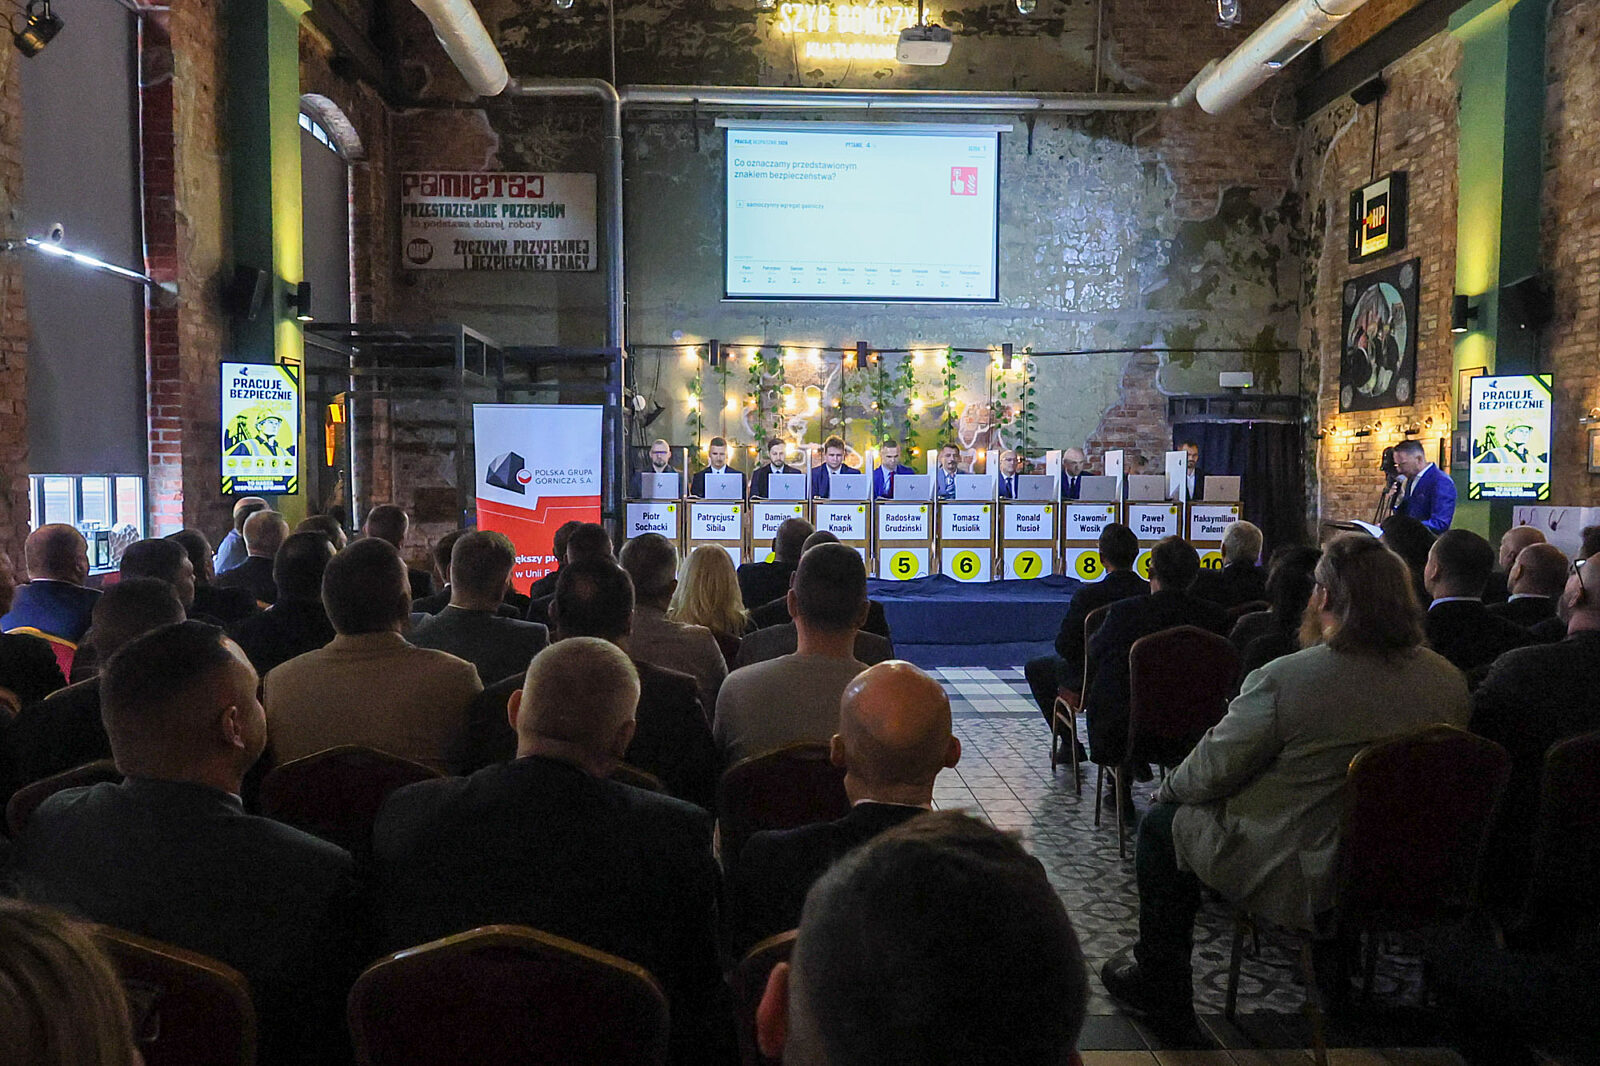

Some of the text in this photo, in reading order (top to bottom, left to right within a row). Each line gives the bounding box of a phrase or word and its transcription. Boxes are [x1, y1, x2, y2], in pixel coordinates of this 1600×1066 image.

[837, 0, 930, 36] BOŃCZY
[734, 158, 856, 171] Co oznaczamy przedstawionym
[734, 170, 836, 180] znakiem bezpieczeństwa?
[402, 201, 565, 218] PRZESTRZEGANIE PRZEPISÓW
[423, 220, 471, 230] podstawa
[474, 220, 505, 230] dobrej
[508, 220, 542, 231] roboty
[513, 239, 590, 255] PRZYJEMNEJ
[472, 255, 548, 270] BEZPIECZNEJ
[552, 255, 590, 270] PRACY
[233, 378, 282, 390] PRACUJĘ
[230, 389, 292, 400] BEZPIECZNIE
[1482, 390, 1534, 400] PRACUJĘ
[1479, 400, 1545, 410] BEZPIECZNIE
[535, 476, 577, 484] GÓRNICZA
[642, 512, 660, 520] Piotr
[697, 513, 735, 523] Patrycjusz
[830, 513, 852, 521] Marek
[885, 513, 922, 522] Radosław
[952, 513, 980, 522] Tomasz
[1016, 513, 1041, 522] Ronald
[1073, 513, 1108, 522] Sławomir
[1141, 514, 1165, 522] Paweł
[1193, 514, 1236, 523] Maksymilian
[635, 522, 668, 532] Sochacki
[706, 523, 726, 532] Sibila
[829, 524, 853, 534] Knapik
[885, 524, 923, 533] Grudziński
[951, 524, 981, 532] Musiolik
[1016, 524, 1041, 532] Musioł
[1079, 524, 1101, 533] Wosik
[1140, 525, 1166, 534] Gałyga
[514, 555, 542, 564] ększy
[898, 557, 910, 574] 5
[960, 557, 972, 573] 6
[1022, 558, 1034, 572] 7
[1084, 557, 1096, 573] 8
[525, 569, 542, 578] Unii
